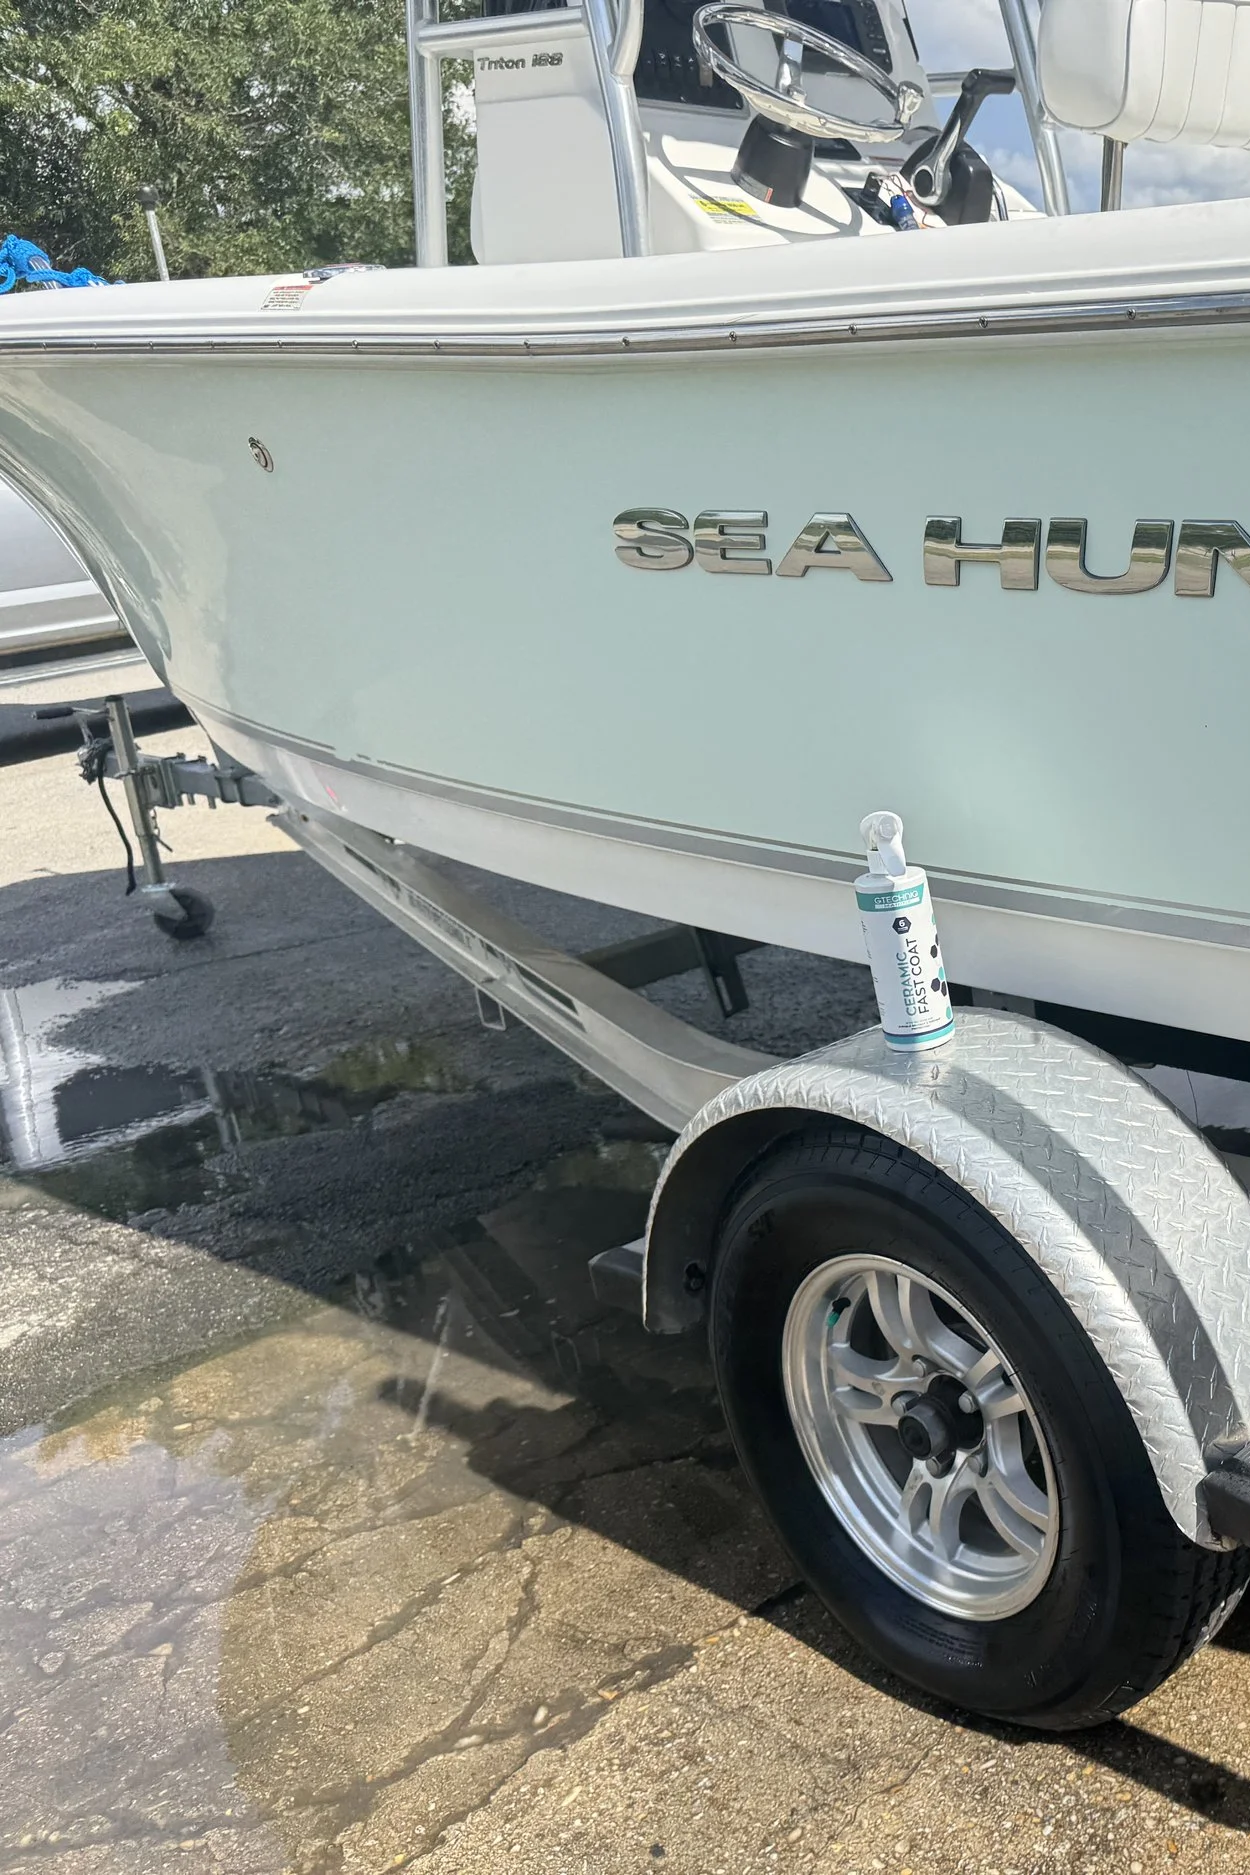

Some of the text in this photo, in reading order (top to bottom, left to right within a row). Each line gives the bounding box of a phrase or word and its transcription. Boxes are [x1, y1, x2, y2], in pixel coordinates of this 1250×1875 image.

[477, 57, 526, 71] Triton
[613, 507, 894, 582] SEA
[906, 938, 922, 976] COAT
[896, 952, 917, 1016] CERAMIC
[913, 979, 930, 1014] FAST
